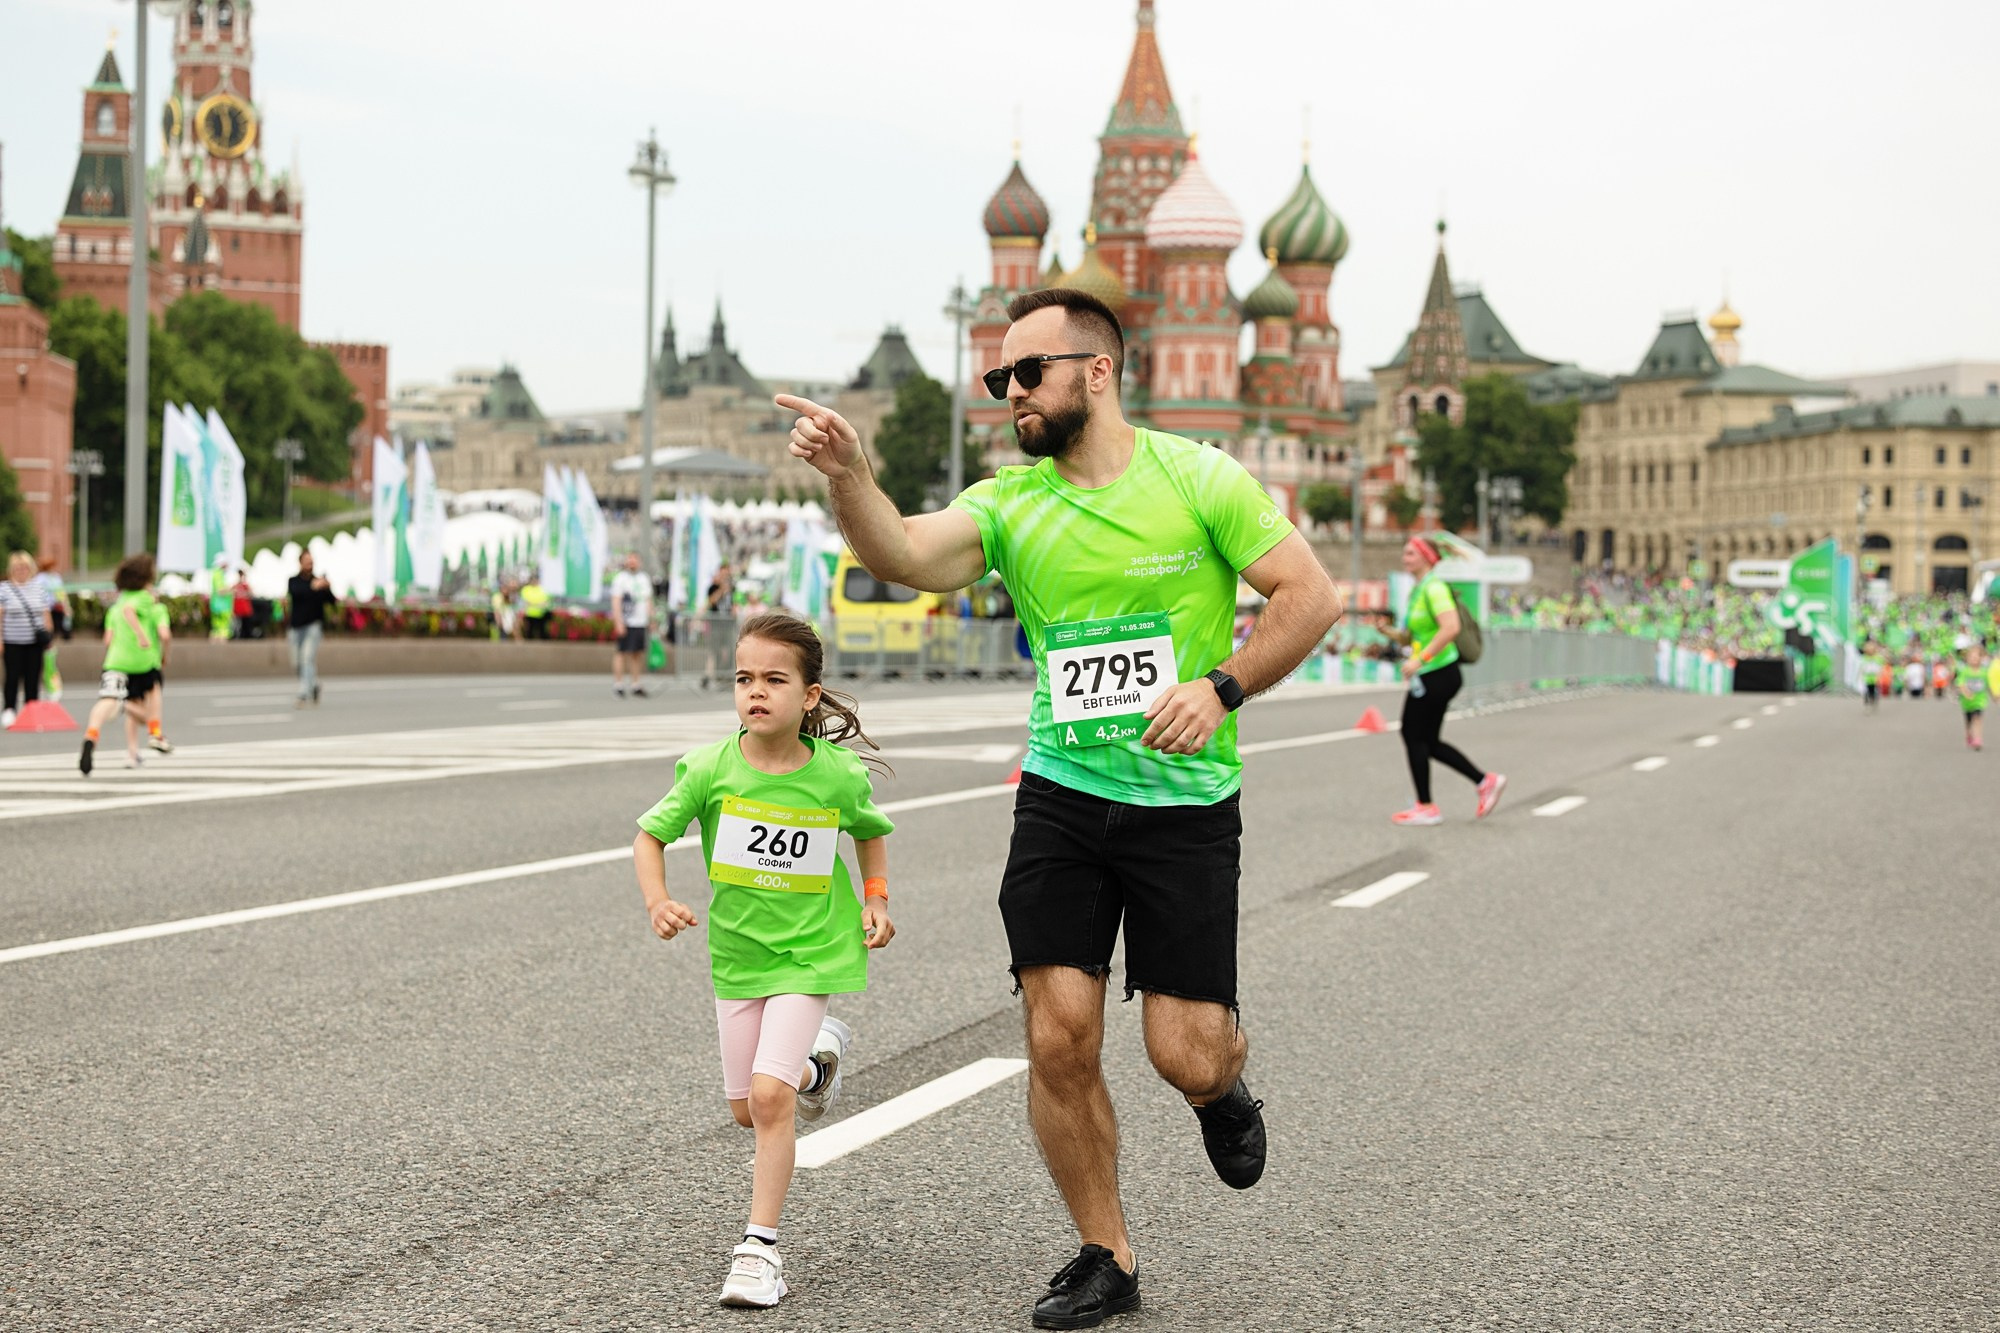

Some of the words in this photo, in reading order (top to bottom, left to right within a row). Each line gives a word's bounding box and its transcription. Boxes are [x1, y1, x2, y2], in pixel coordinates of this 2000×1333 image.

[1130, 550, 1185, 566] зелёный
[1124, 564, 1181, 578] марафон
[1119, 621, 1156, 632] 31.05.2025
[1063, 650, 1158, 697] 2795
[1083, 690, 1141, 710] ЕВГЕНИЙ
[747, 825, 809, 858] 260
[758, 857, 792, 869] СОФИЯ
